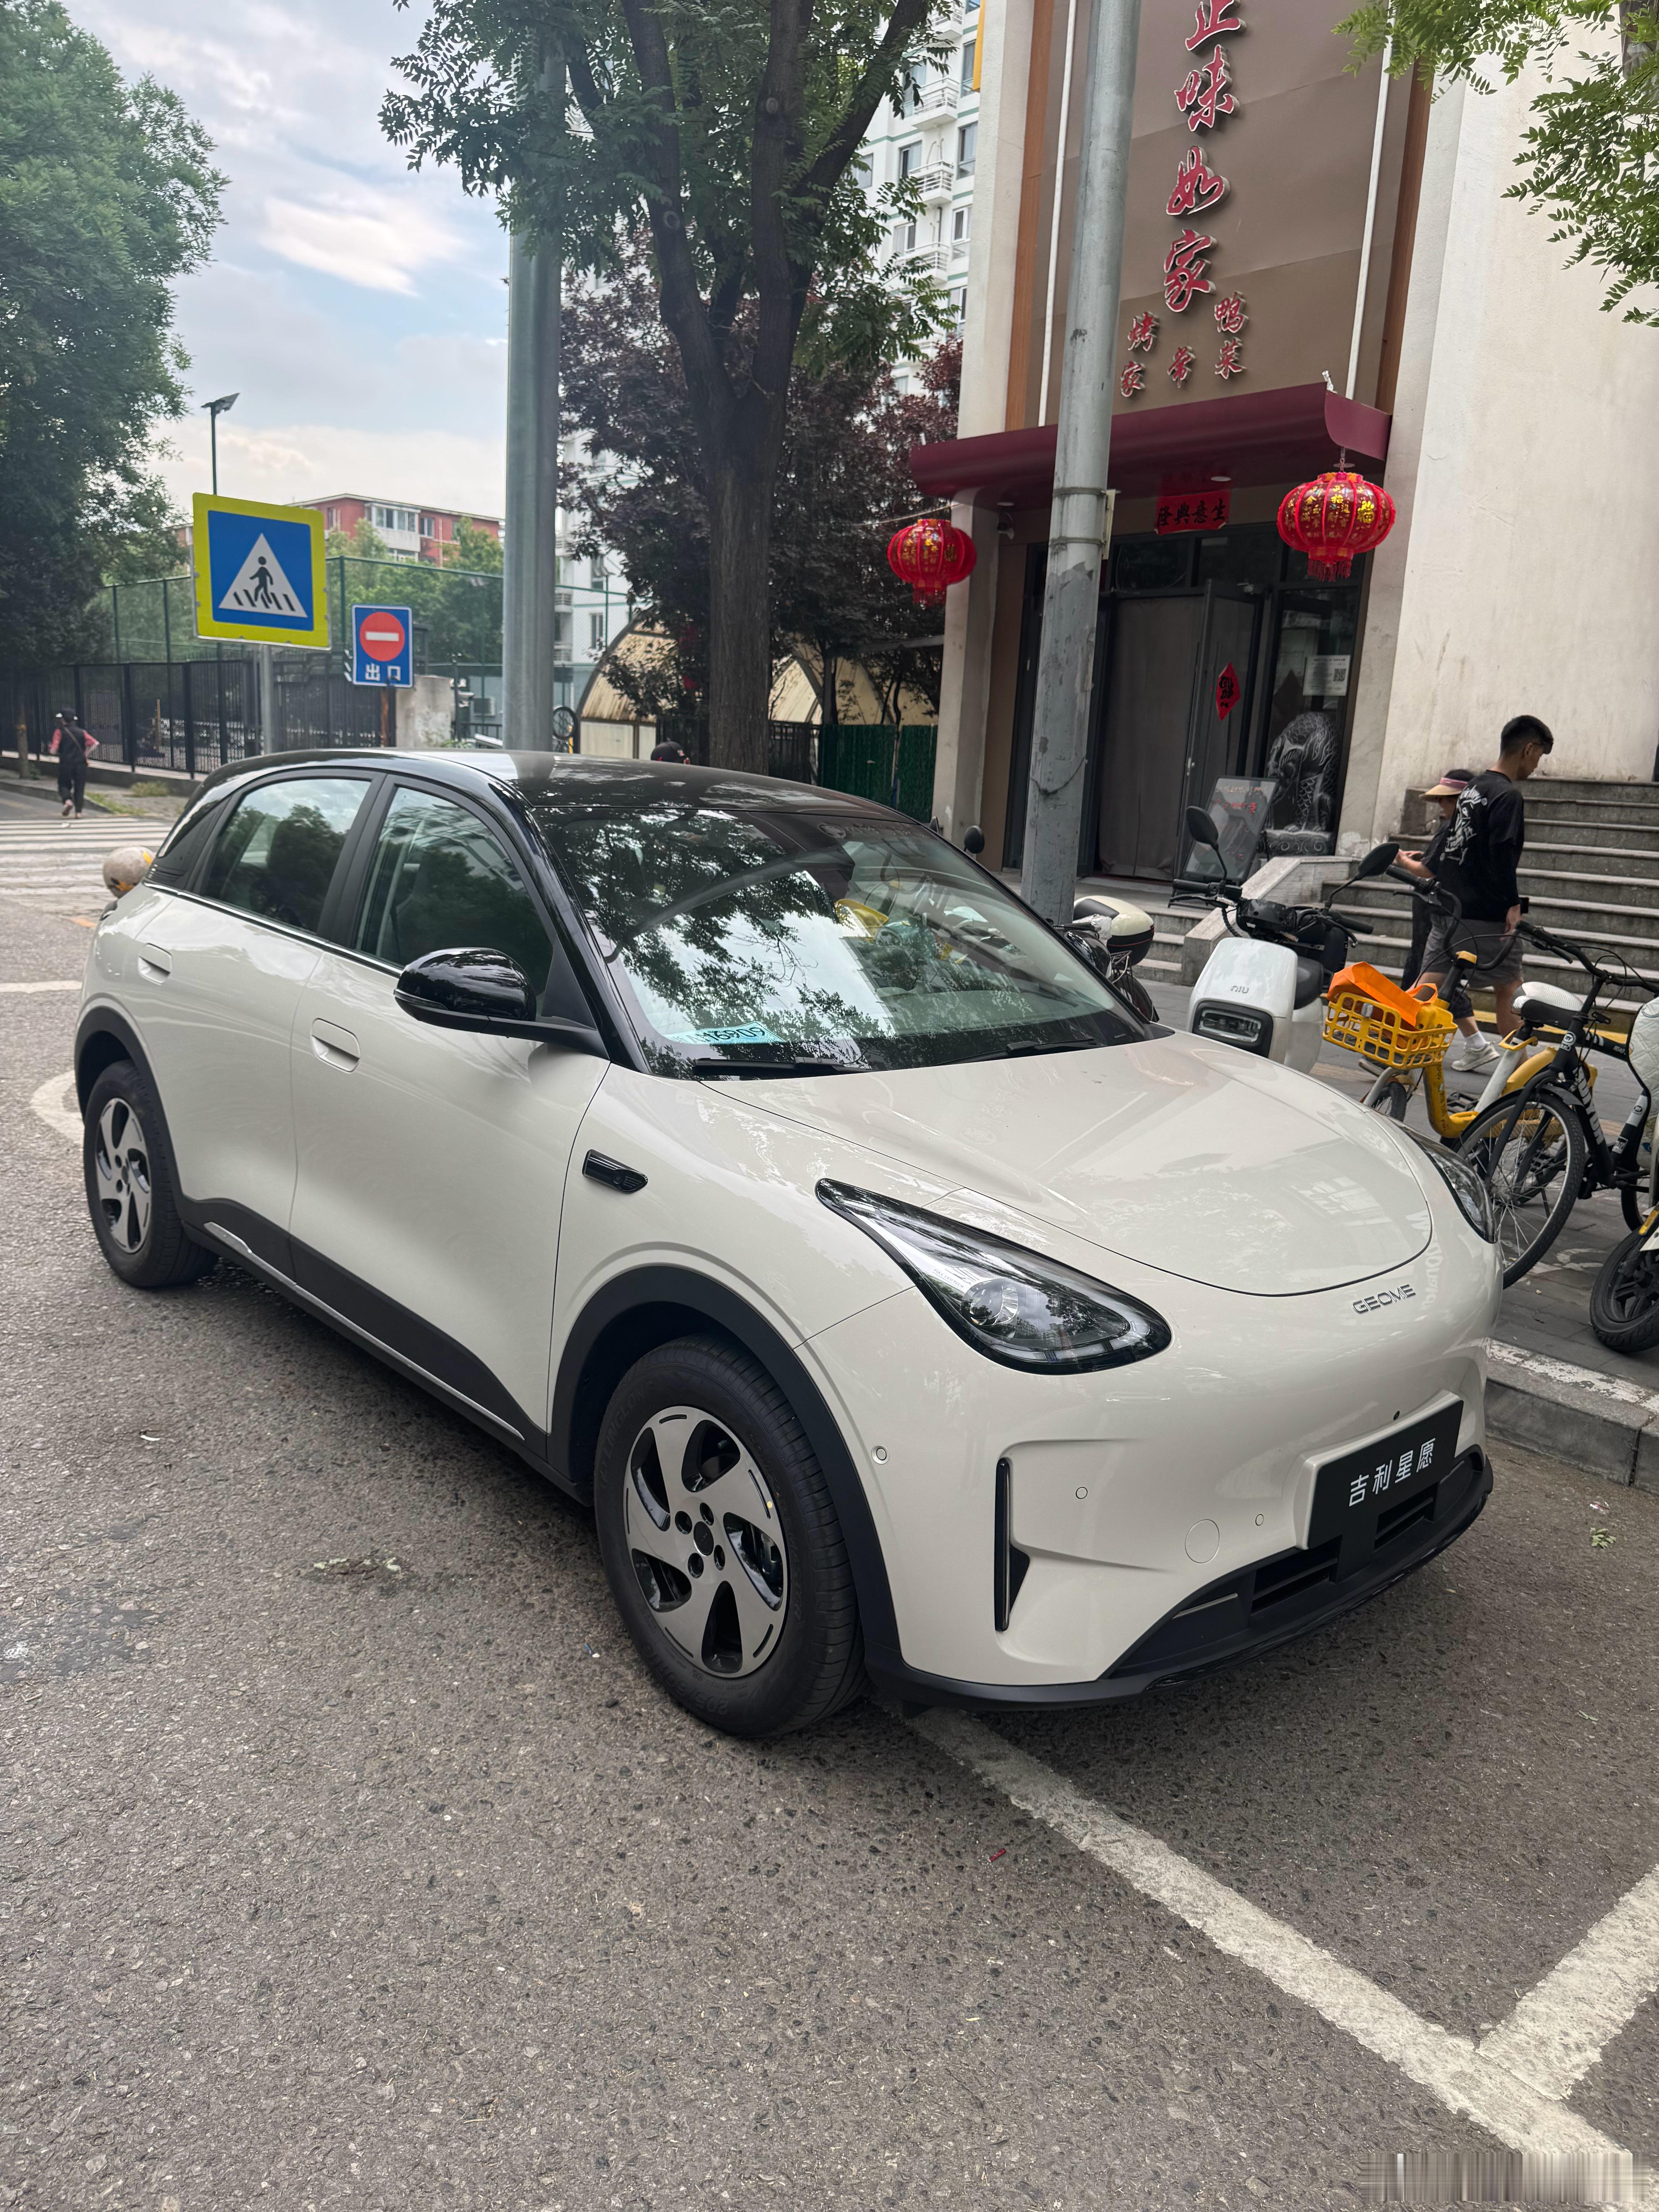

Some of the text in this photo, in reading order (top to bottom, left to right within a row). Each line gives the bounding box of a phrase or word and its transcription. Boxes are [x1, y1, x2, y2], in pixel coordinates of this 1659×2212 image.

[1120, 338, 1246, 397] 家常菜
[365, 662, 402, 682] 出口
[1352, 1283, 1416, 1314] GEOME
[1348, 1437, 1436, 1508] 吉利星愿
